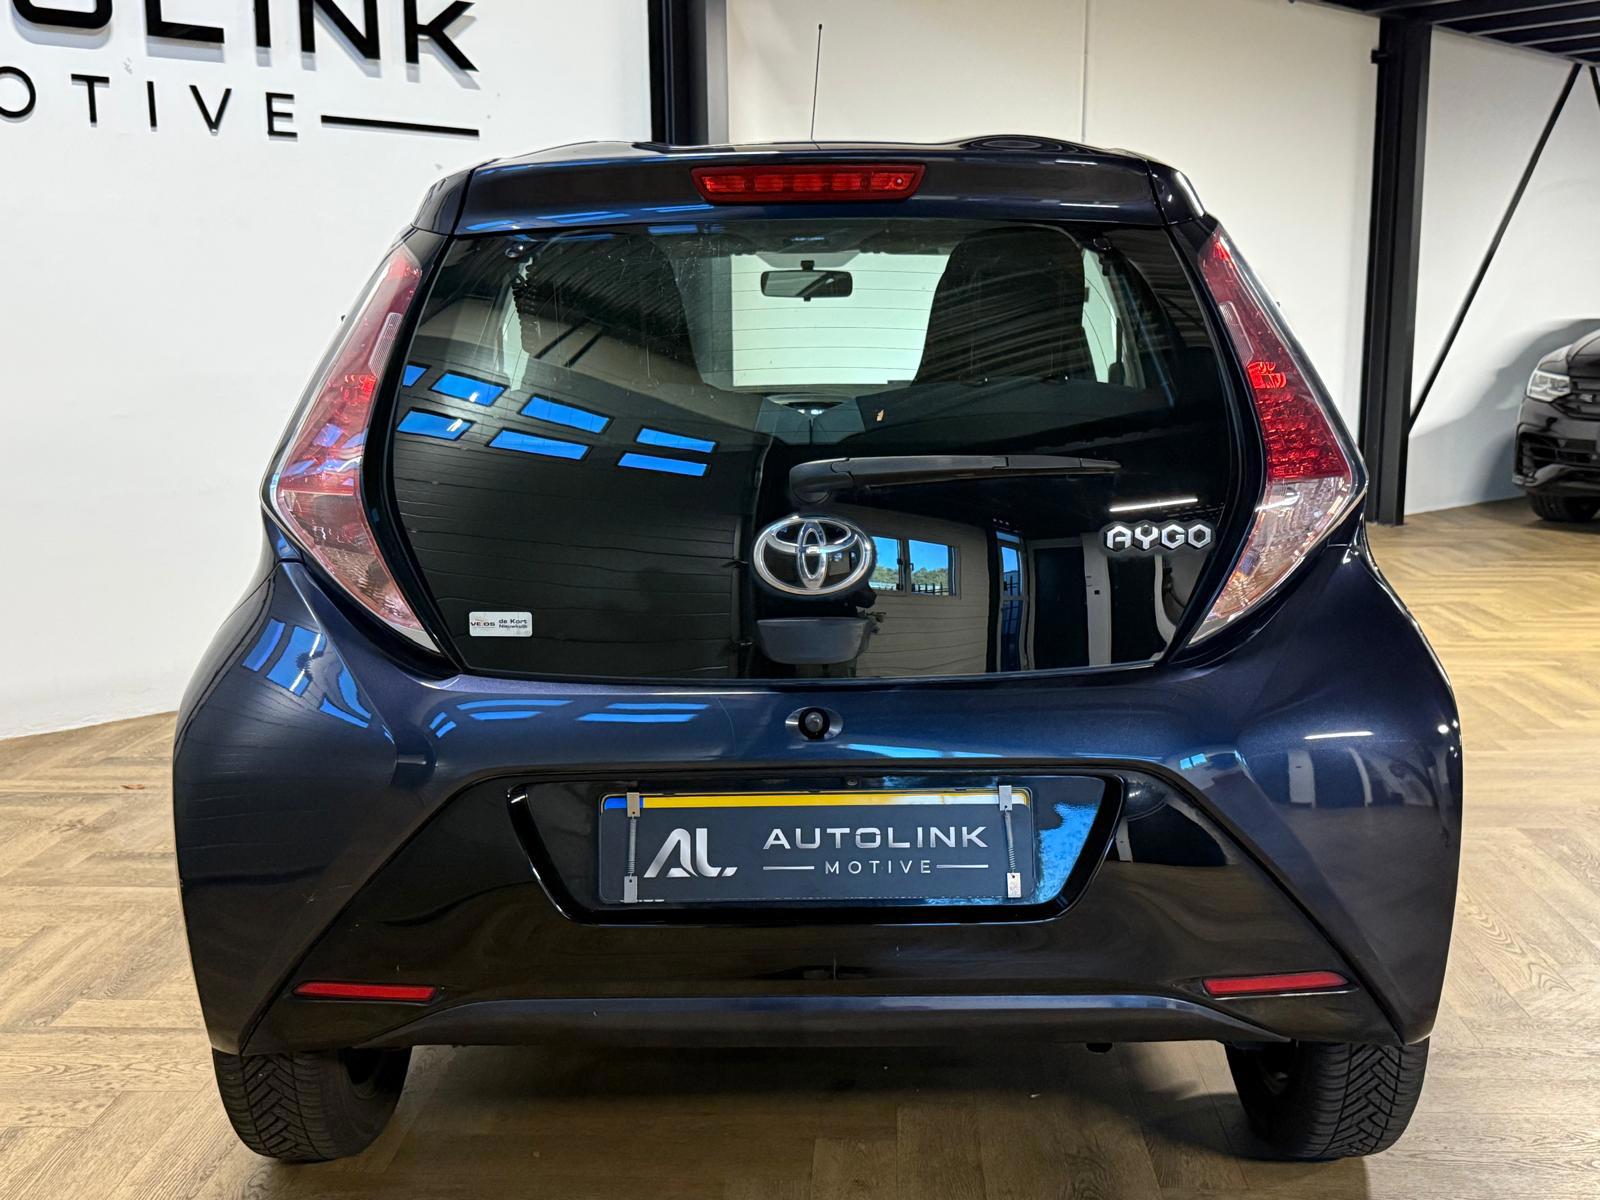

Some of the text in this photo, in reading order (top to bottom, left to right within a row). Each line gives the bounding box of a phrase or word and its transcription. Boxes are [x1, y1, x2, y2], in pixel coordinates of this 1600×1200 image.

[1106, 524, 1212, 550] AYGO
[763, 826, 989, 850] AUTOLINK
[824, 859, 932, 875] MOTIVE
